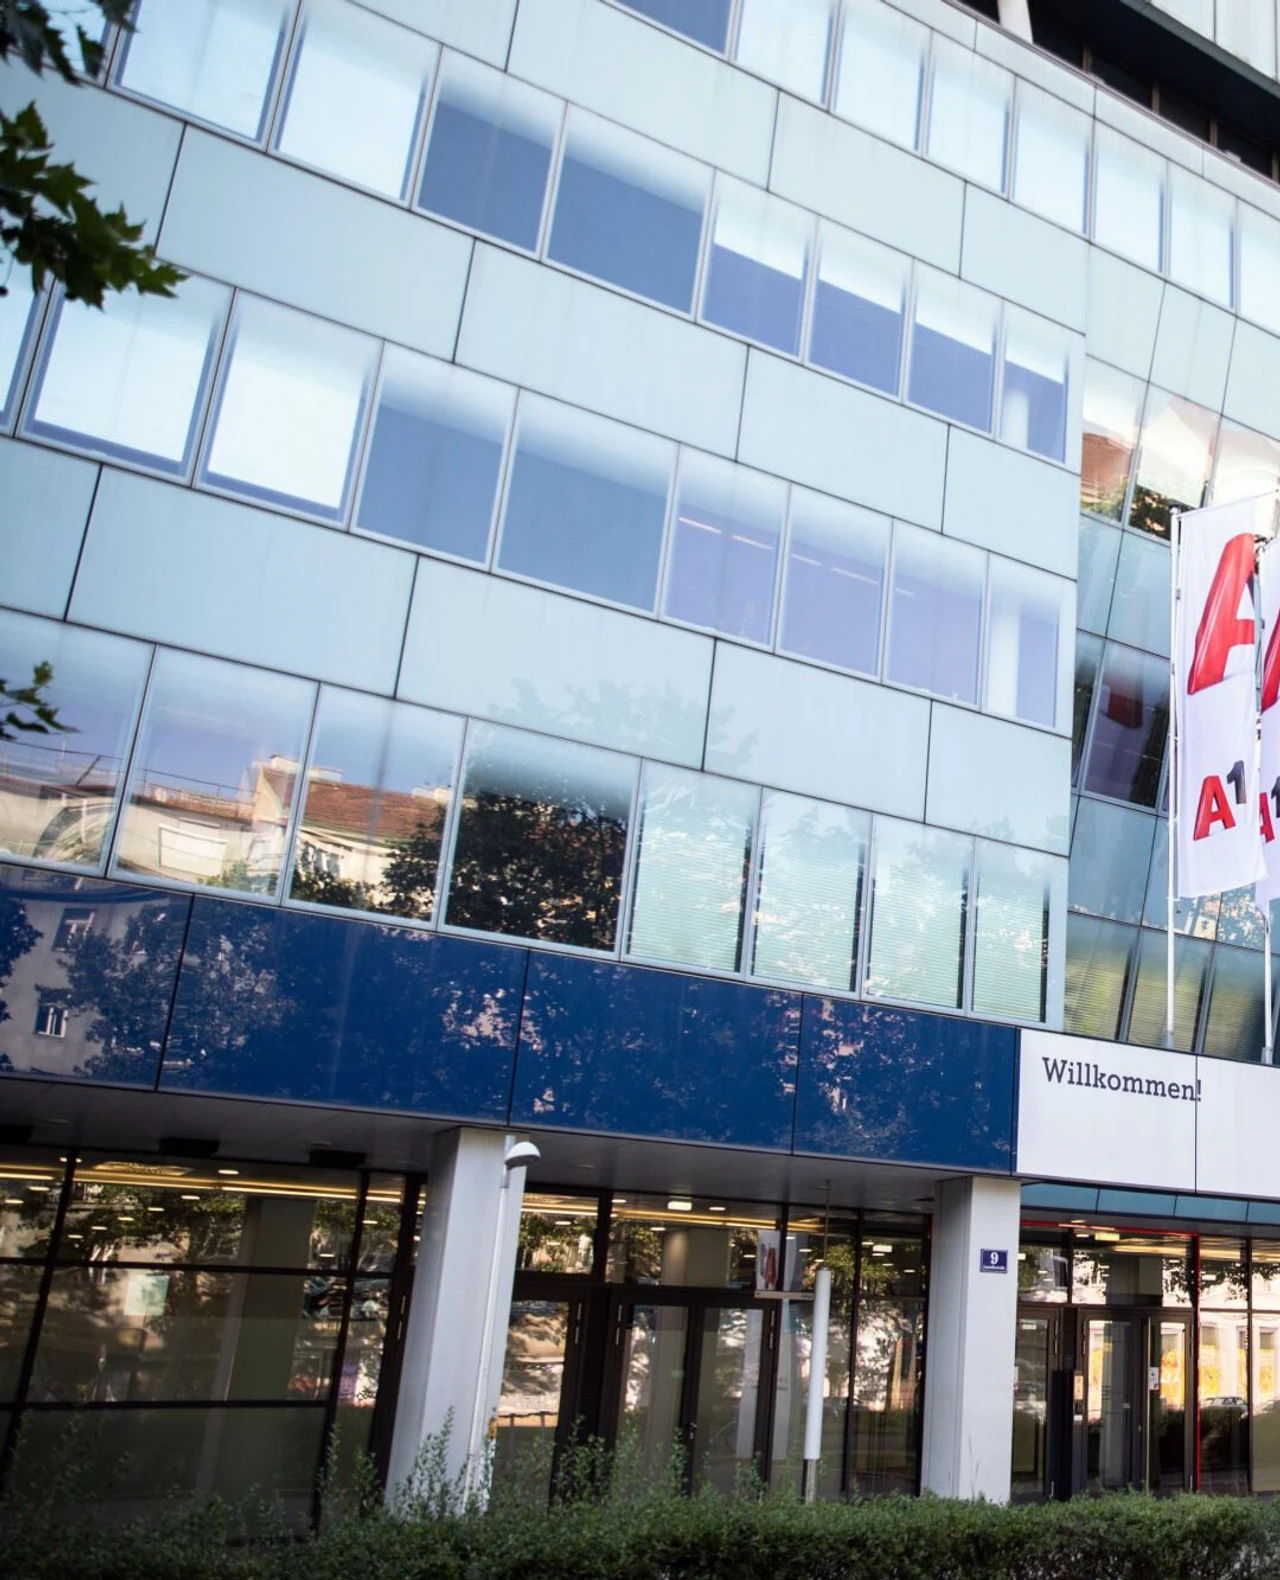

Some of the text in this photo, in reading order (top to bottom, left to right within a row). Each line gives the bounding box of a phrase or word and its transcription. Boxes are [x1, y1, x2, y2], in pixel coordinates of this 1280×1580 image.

[1193, 760, 1247, 842] A1
[1041, 1056, 1203, 1103] Willkommen!
[990, 1251, 999, 1265] 9
